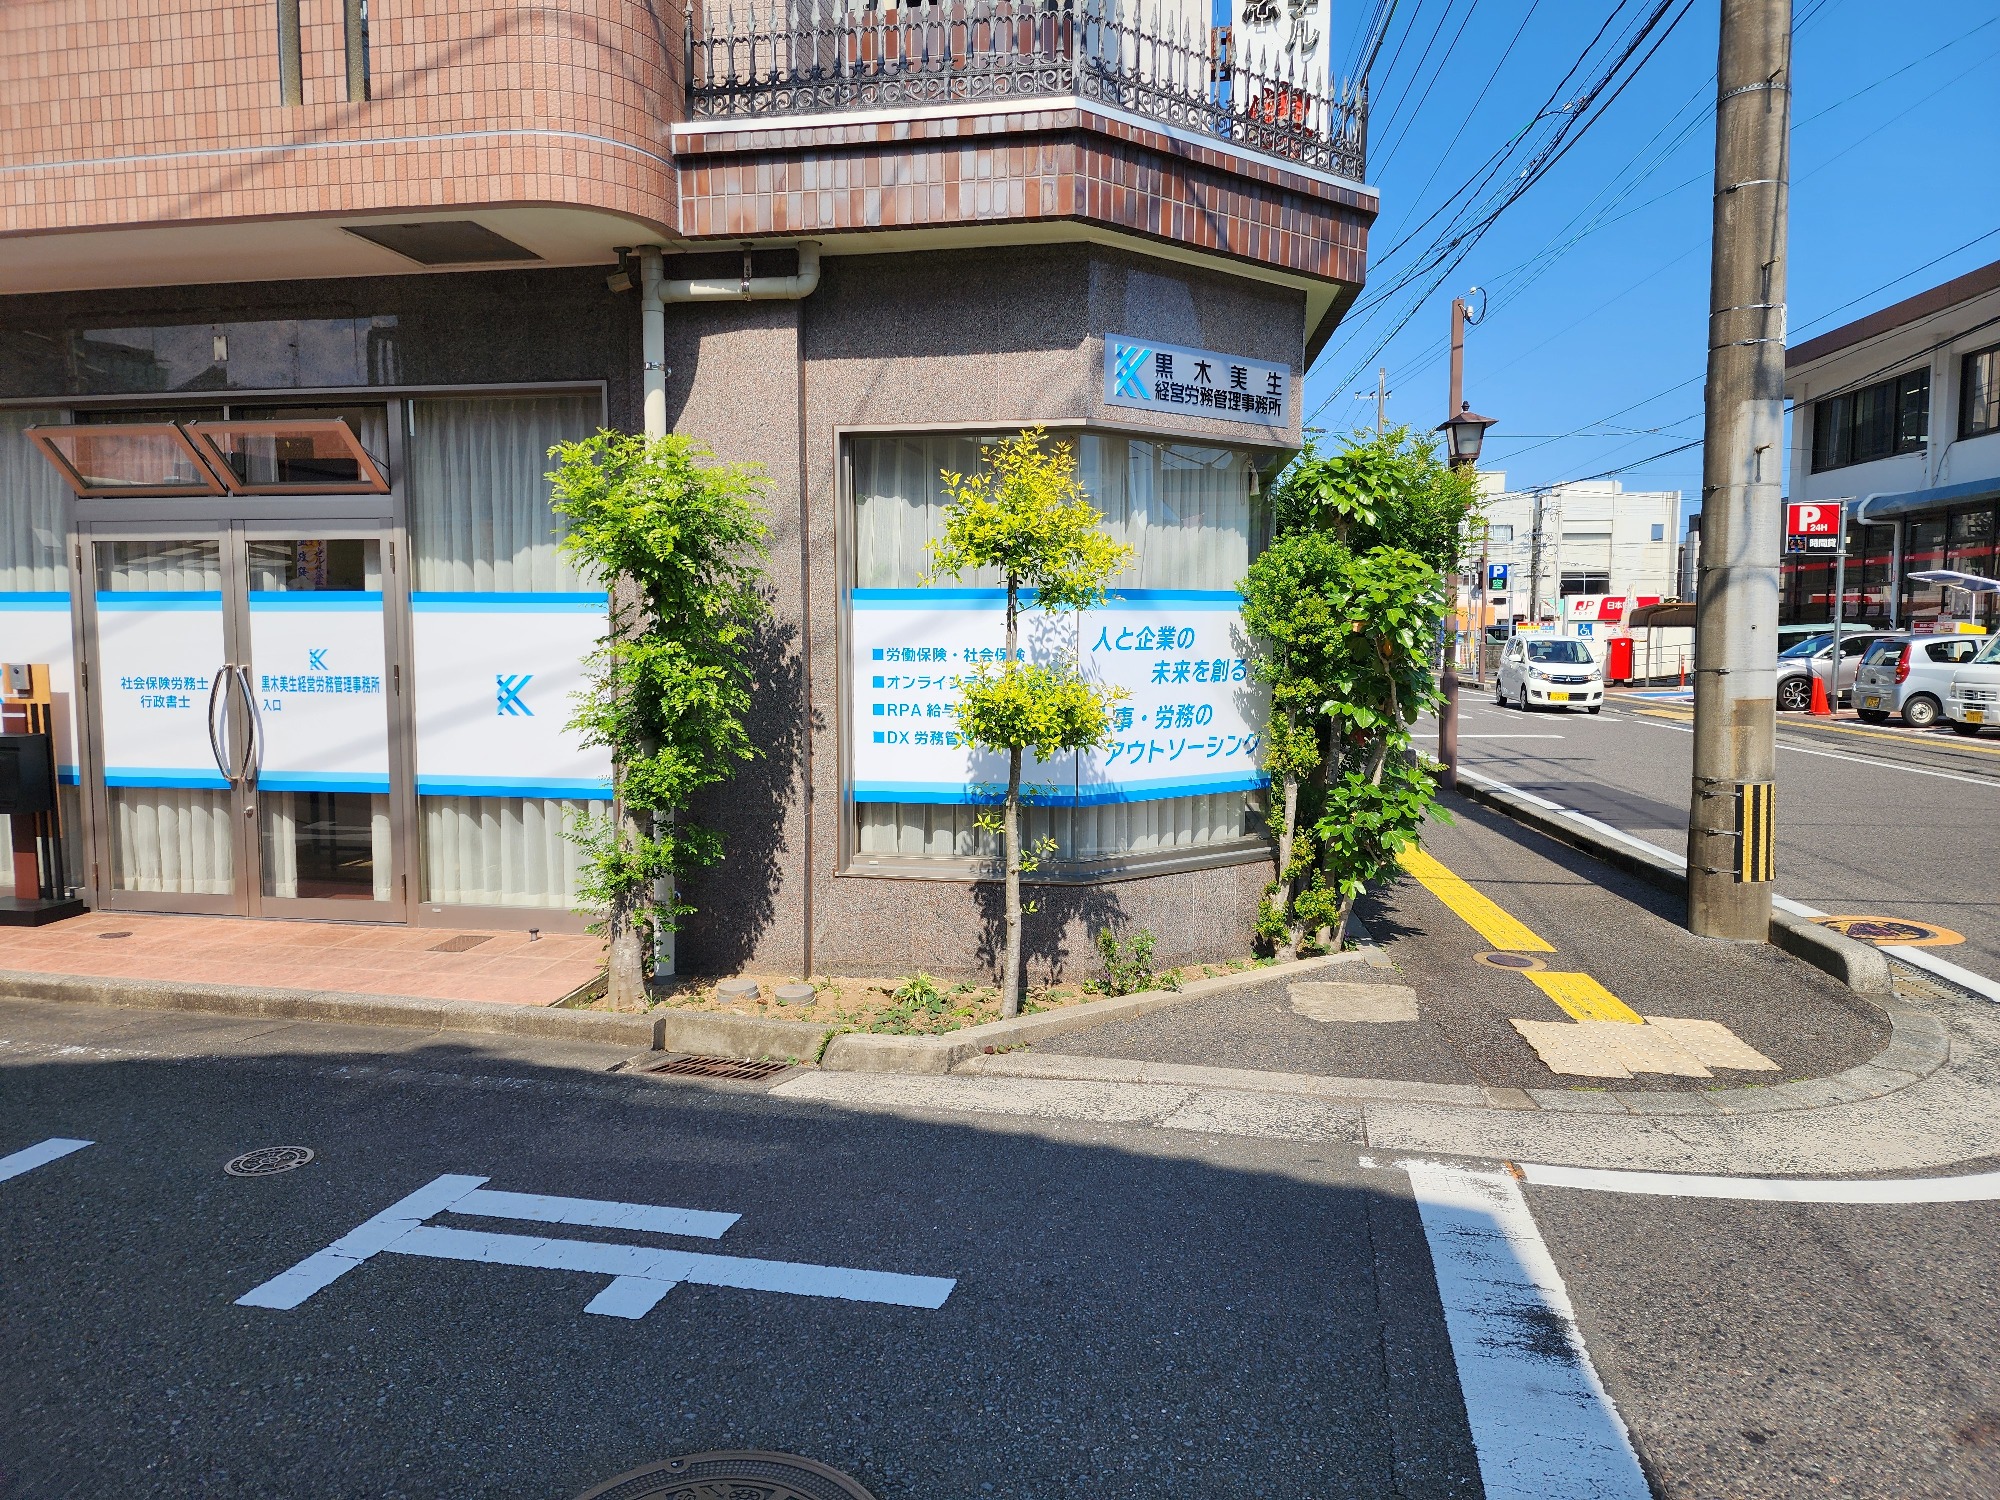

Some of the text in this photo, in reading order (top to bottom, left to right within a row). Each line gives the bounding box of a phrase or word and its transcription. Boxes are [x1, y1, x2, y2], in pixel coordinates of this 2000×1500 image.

[1155, 352, 1283, 396] 黒木美生
[1154, 380, 1282, 417] 経営労務管理事務所
[1798, 506, 1821, 532] P
[1809, 524, 1828, 532] 24H
[1493, 566, 1504, 577] P
[1092, 626, 1196, 652] 人と企業の
[1151, 658, 1247, 685] 未来を創る
[120, 676, 209, 691] 社会保険労務士
[261, 675, 380, 694] 黒木美生経営労務管理事務所
[140, 694, 191, 709] 行政書士
[263, 700, 282, 711] 入口
[887, 703, 922, 717] RPA
[887, 731, 910, 744] DX
